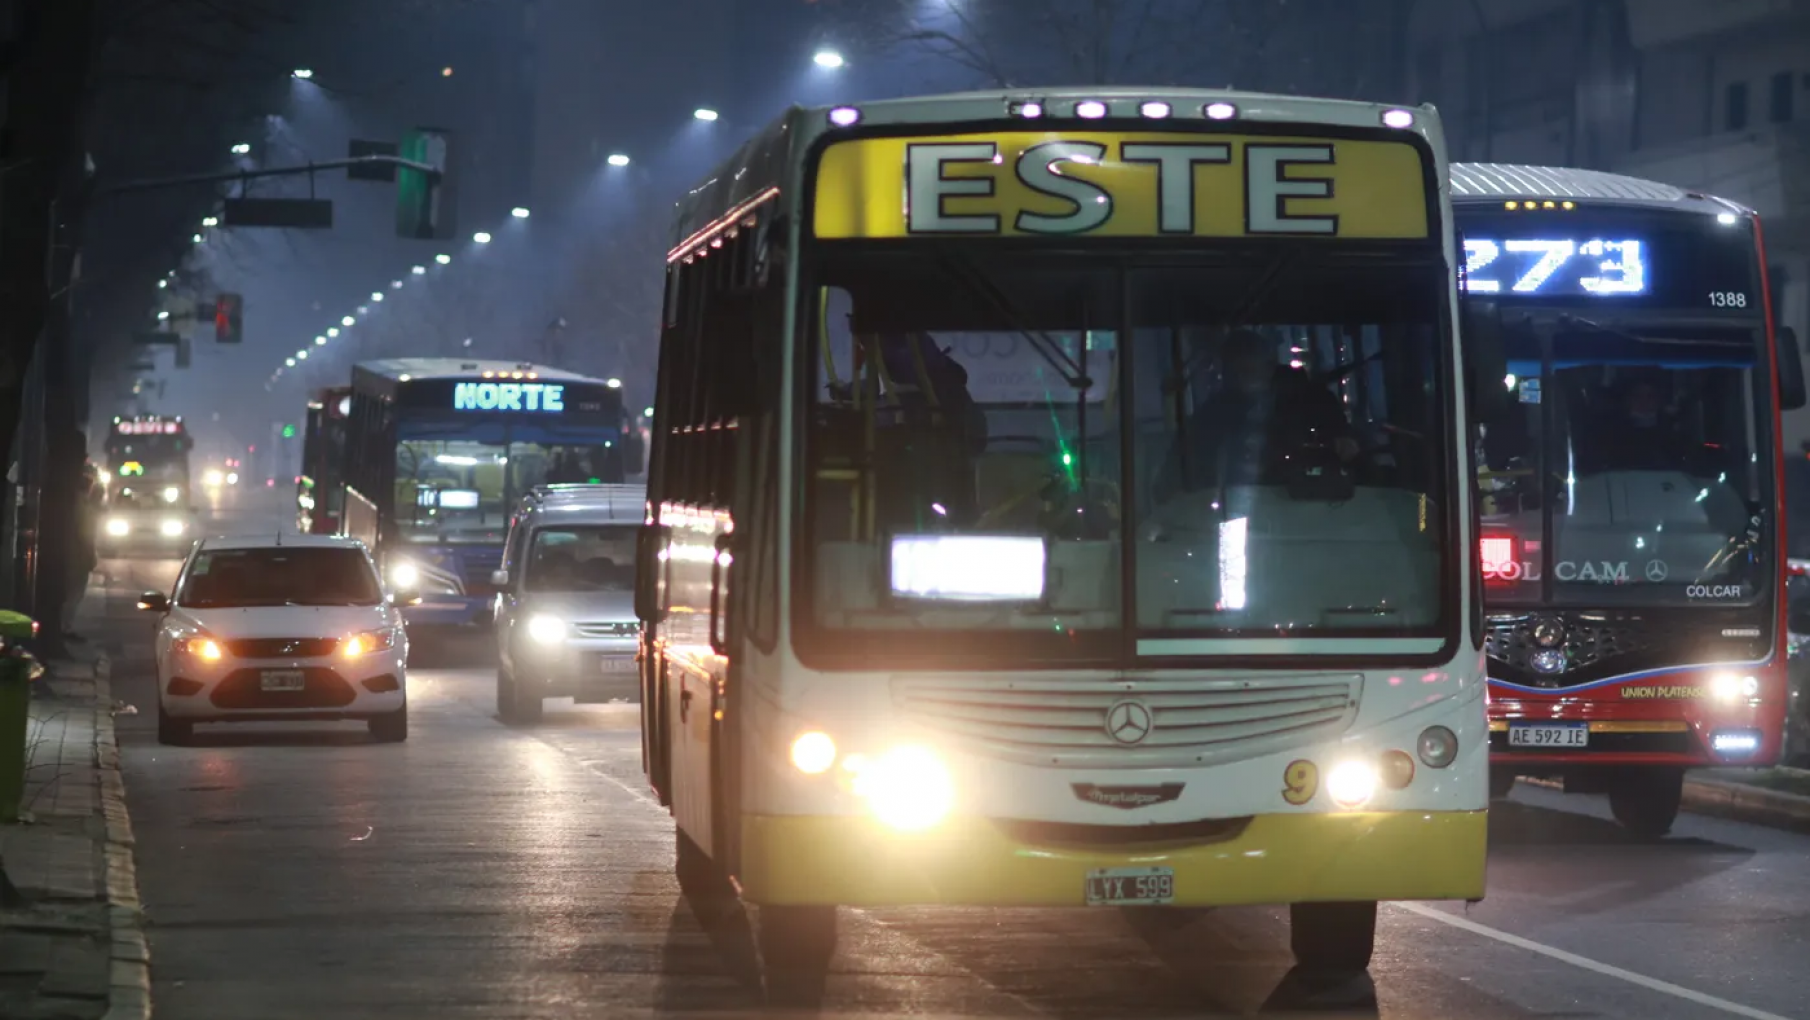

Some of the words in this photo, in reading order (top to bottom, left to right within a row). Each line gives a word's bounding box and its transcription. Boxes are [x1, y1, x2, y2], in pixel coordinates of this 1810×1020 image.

[905, 141, 1340, 235] ESTE
[1459, 239, 1644, 293] 273
[1708, 292, 1746, 308] 1388
[454, 382, 565, 411] NORTE
[1554, 561, 1630, 581] CAM
[1686, 585, 1741, 597] COLCAR
[1621, 686, 1655, 699] UNION
[1512, 729, 1530, 744] AE
[1535, 729, 1562, 744] 592
[1567, 729, 1584, 745] IE
[1281, 759, 1319, 806] 9
[1089, 878, 1124, 900] LYX
[1136, 875, 1171, 898] 599
